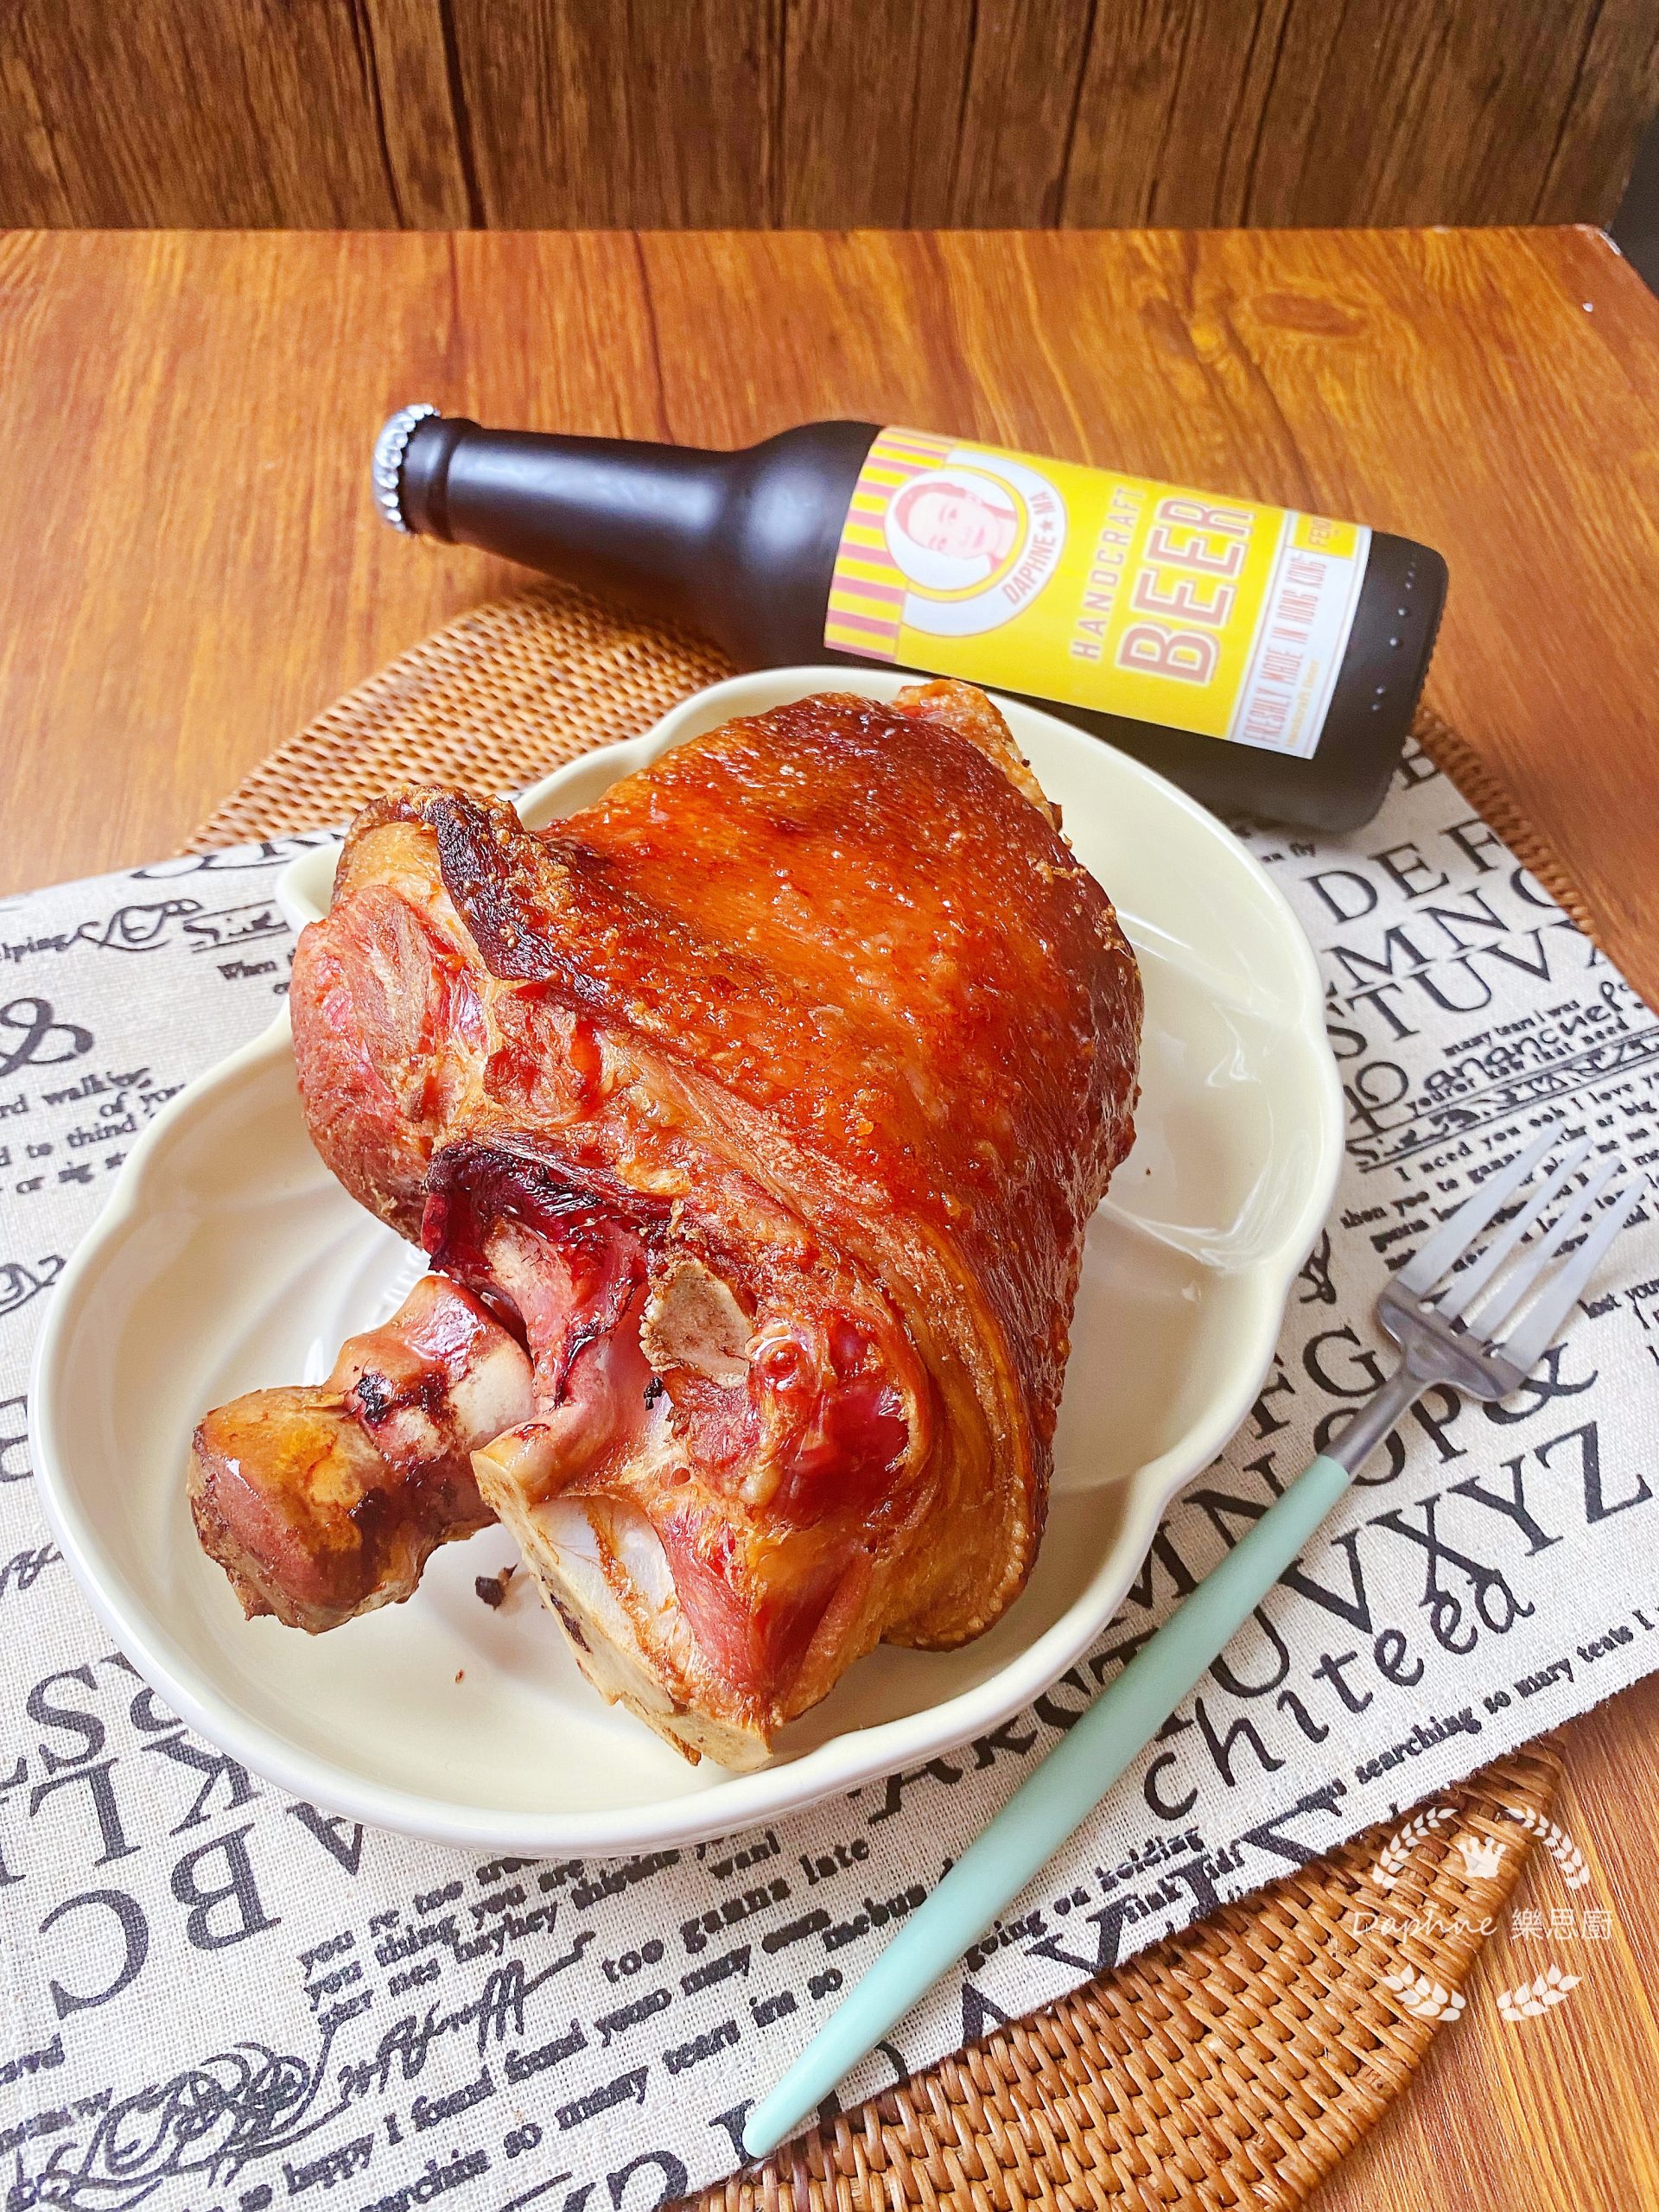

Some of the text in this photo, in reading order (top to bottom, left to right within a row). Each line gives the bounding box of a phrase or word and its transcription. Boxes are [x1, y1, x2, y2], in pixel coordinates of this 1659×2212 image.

[1002, 491, 1057, 606] DAPHNE MA
[1071, 486, 1144, 660] HANDCRAFT
[1114, 495, 1255, 689] BEER
[1276, 588, 1319, 625] HONG
[1271, 626, 1309, 645] IN
[1259, 646, 1304, 686] MADE
[1243, 686, 1293, 745] FRESHLY
[1480, 1126, 1522, 1151] you
[1587, 1083, 1634, 1105] love
[1482, 1689, 1513, 1715] so
[601, 1939, 664, 1983] too
[798, 1838, 870, 1885] late
[384, 2112, 404, 2146] I
